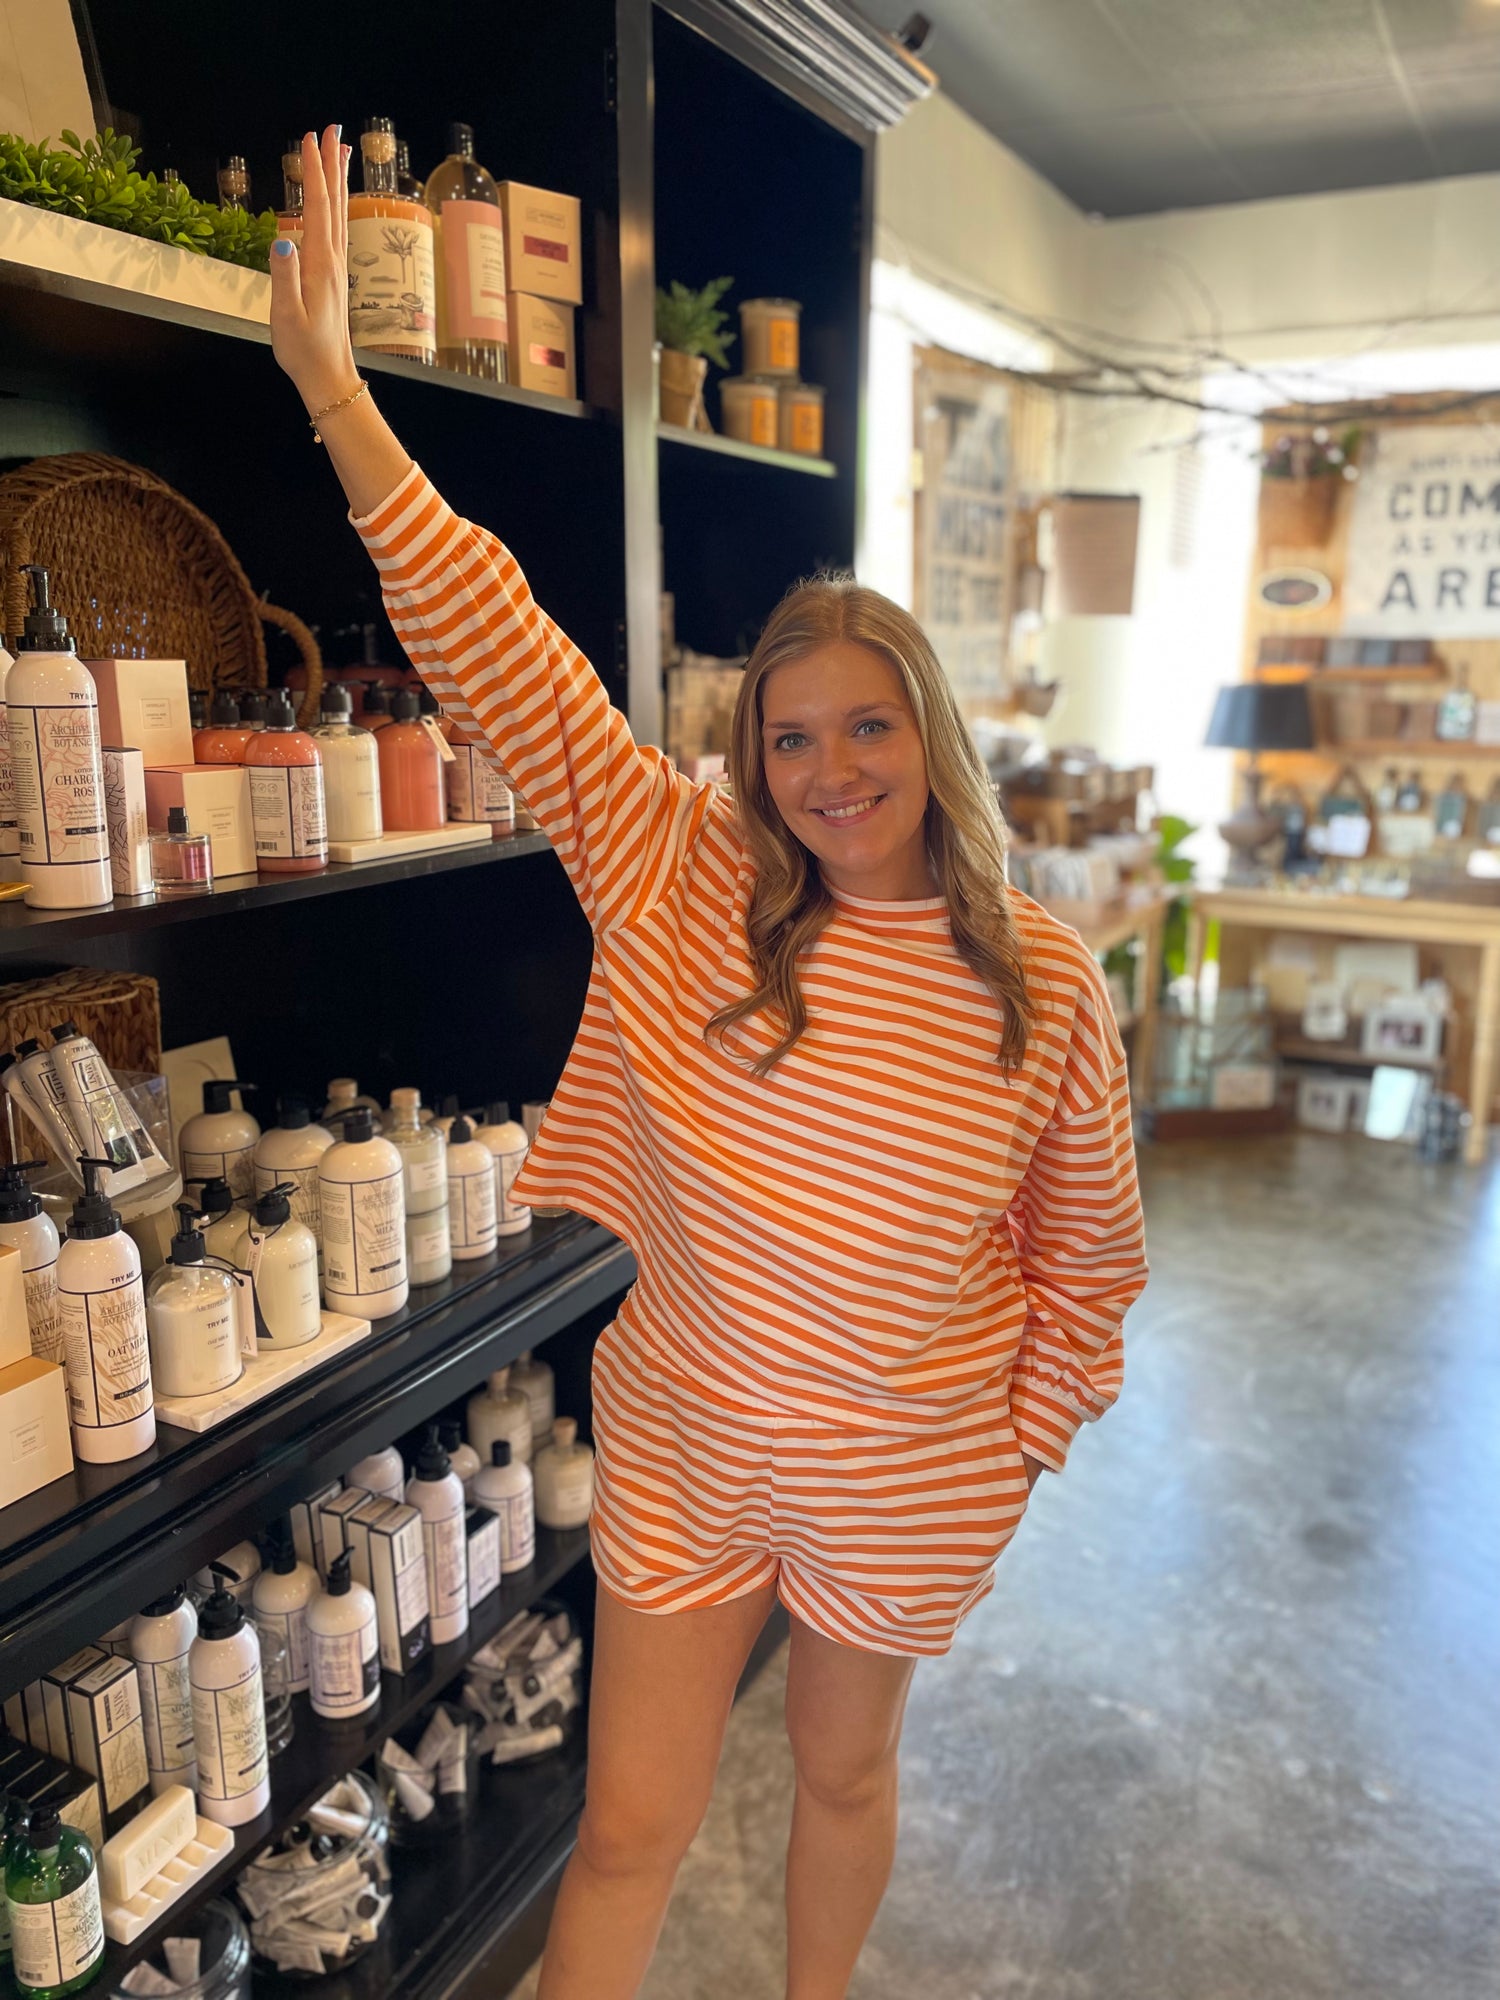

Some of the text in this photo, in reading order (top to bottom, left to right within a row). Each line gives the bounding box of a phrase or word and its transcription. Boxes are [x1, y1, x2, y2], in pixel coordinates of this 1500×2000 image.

[69, 692, 84, 700] TRY
[110, 1270, 135, 1285] TRY ME
[206, 1319, 220, 1329] TRY
[108, 1347, 127, 1358] OAT
